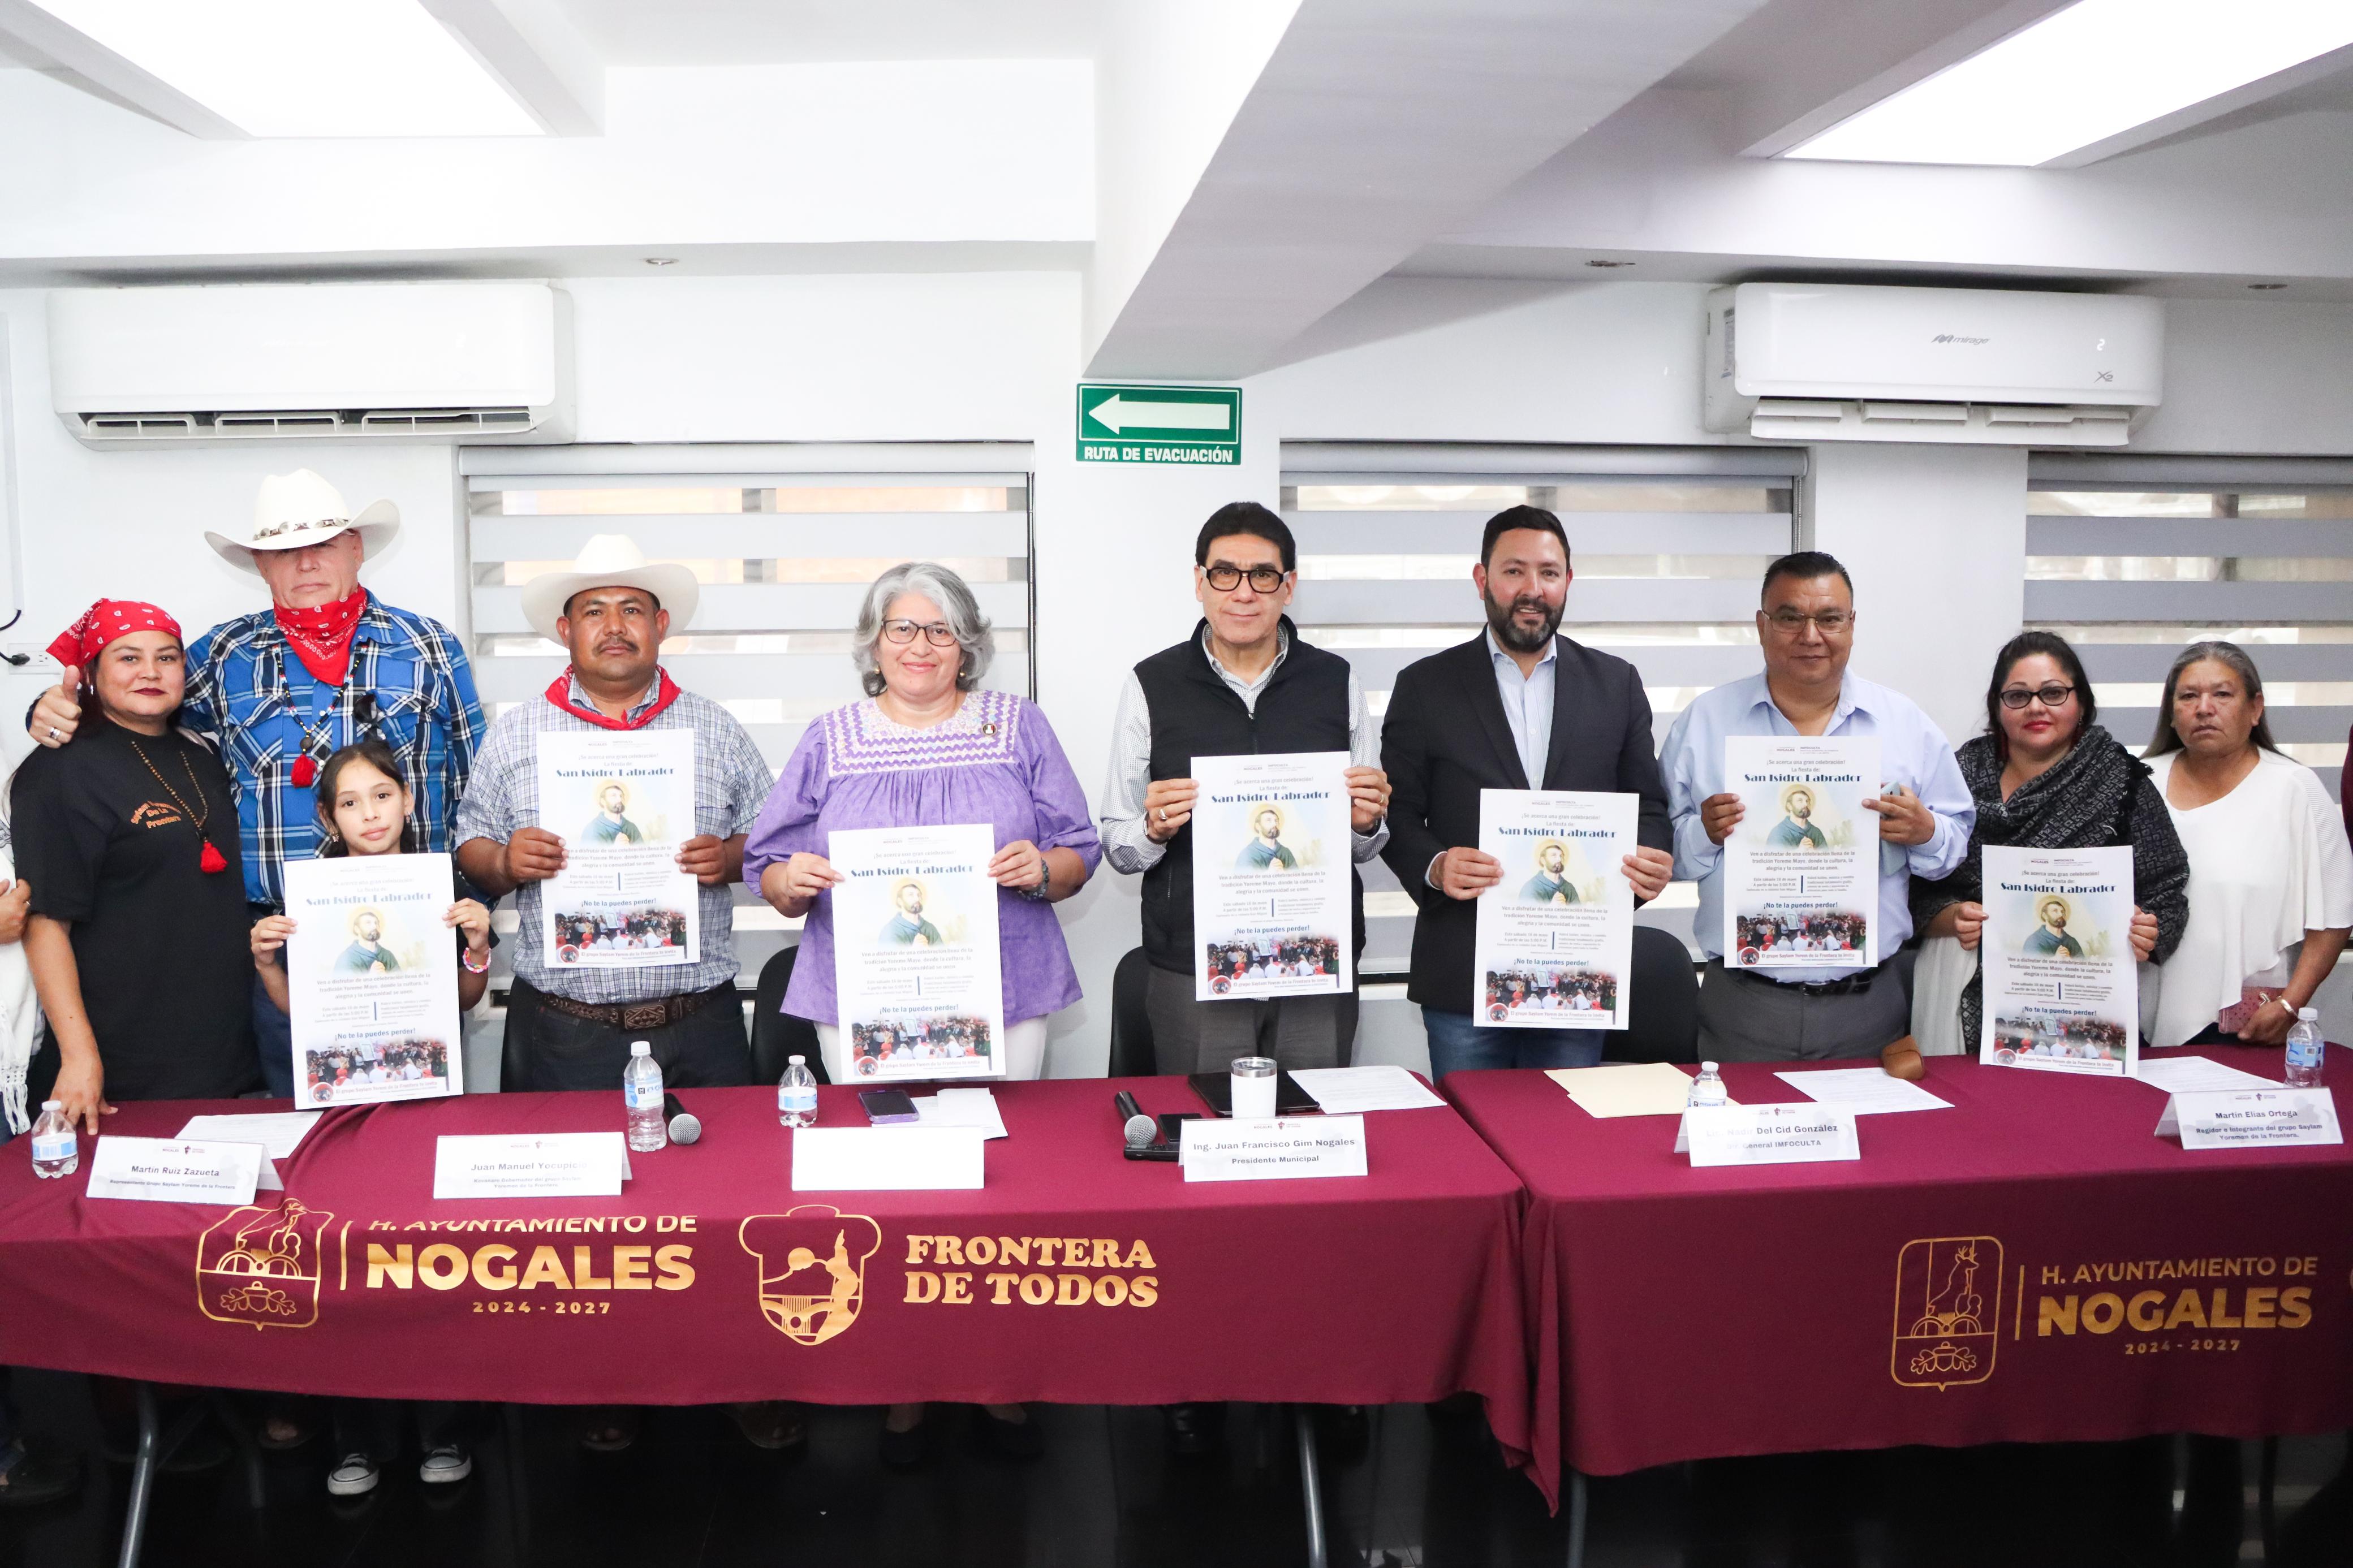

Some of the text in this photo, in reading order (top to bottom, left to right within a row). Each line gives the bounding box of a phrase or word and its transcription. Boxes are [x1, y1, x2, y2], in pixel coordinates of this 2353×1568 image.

[1951, 335, 1990, 345] mirage
[2097, 339, 2105, 351] 2
[1084, 446, 1232, 463] RUTA DE EVACUACIÓN
[1274, 792, 1331, 800] Labrador
[1561, 829, 1618, 837] Labrador
[916, 865, 973, 874] Labrador
[334, 896, 368, 904] Isidro
[373, 893, 432, 902] Labrador
[634, 898, 656, 907] perder!
[1815, 902, 1838, 910] perder!
[391, 1028, 415, 1036] perder!
[1316, 1139, 1354, 1147] Nogales
[368, 1215, 697, 1232] H. AYUNTAMIENTO DE
[905, 1235, 1156, 1268] FRONTERA
[367, 1243, 695, 1290] NOGALES
[2042, 1257, 2317, 1285] H. AYUNTAMIENTO DE
[903, 1272, 1158, 1307] DE TODOS
[473, 1302, 531, 1312] 2024
[555, 1302, 610, 1314] 2027
[2038, 1287, 2312, 1336] NOGALES
[2126, 1341, 2170, 1354] 2024
[2191, 1339, 2240, 1350] 2027
